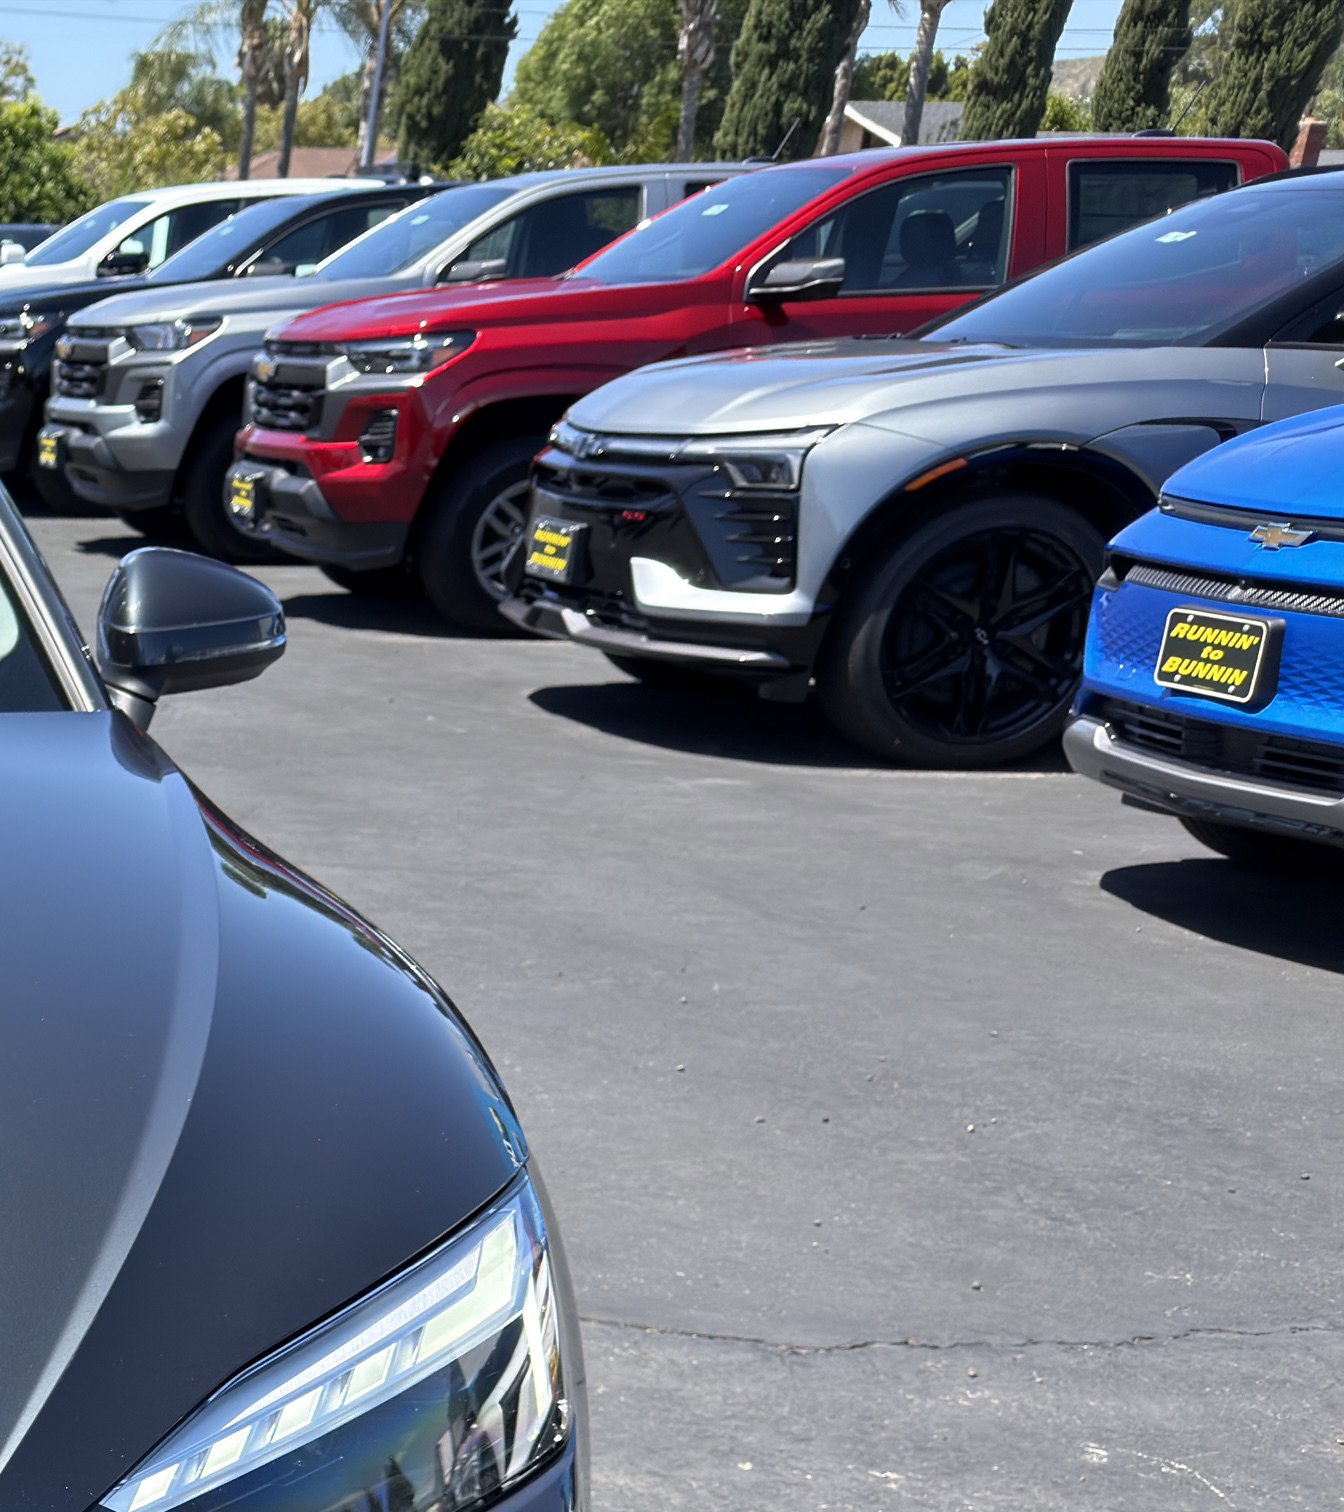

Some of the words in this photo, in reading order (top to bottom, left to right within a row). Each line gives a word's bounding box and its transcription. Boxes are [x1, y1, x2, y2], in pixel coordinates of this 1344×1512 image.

[1170, 622, 1260, 650] RUNNIN'
[1200, 645, 1224, 660] to
[1161, 656, 1248, 686] BUNNIN
